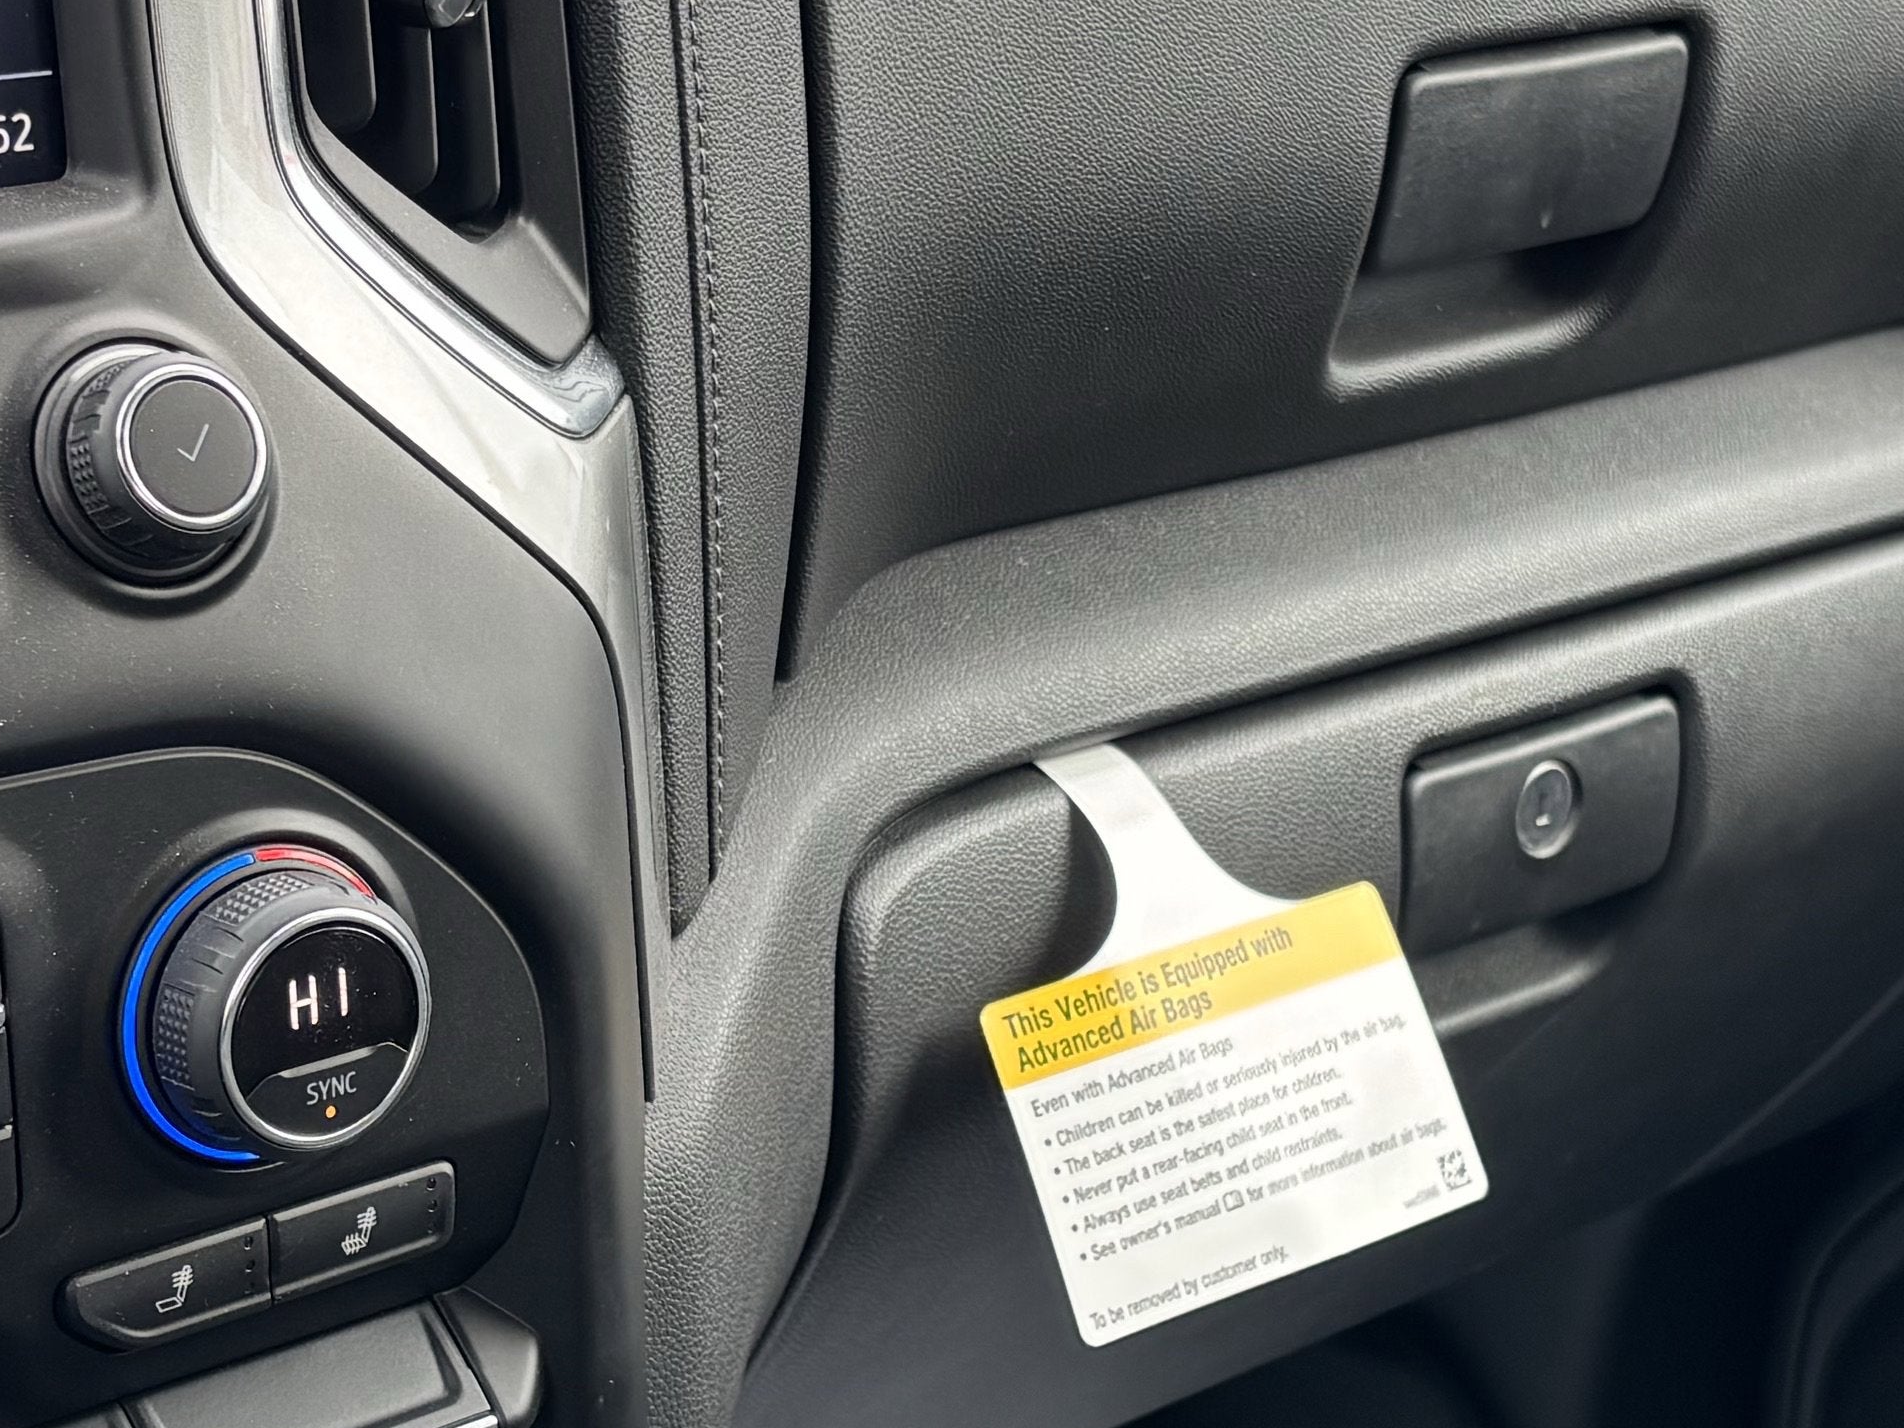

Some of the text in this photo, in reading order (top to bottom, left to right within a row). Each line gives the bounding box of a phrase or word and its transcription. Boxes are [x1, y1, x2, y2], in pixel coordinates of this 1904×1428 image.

[286, 966, 352, 1032] HI
[1001, 926, 1294, 1040] This Vehicle is Equipped with
[1017, 989, 1213, 1073] Advanced Air Bags
[304, 1073, 359, 1107] SYNC
[1030, 1037, 1234, 1118] Even with Advanced Air Bags
[1055, 1114, 1116, 1147] Children
[1118, 1105, 1144, 1123] can
[1146, 1096, 1165, 1116] be
[1165, 1082, 1204, 1108] killed
[1206, 1077, 1219, 1094] or
[1222, 1057, 1279, 1089] seriously
[1280, 1040, 1322, 1070] injured
[1323, 1036, 1339, 1053] by
[1340, 1028, 1361, 1045] the
[1363, 1020, 1379, 1038] air
[1063, 1066, 1342, 1175] The back seat is the safest place for children.
[1072, 1091, 1353, 1204] Never put a rear-facing child seat in the front.
[1082, 1126, 1344, 1233] Always use seat belts and child restraints.
[1090, 1242, 1117, 1261] See
[1120, 1220, 1173, 1250] owner's
[1174, 1199, 1221, 1230] manual
[1246, 1185, 1265, 1202] for
[1266, 1173, 1299, 1197] more
[1301, 1146, 1366, 1183] information
[1367, 1133, 1399, 1160] about
[1399, 1127, 1415, 1146] air
[1089, 1311, 1107, 1331] To
[1108, 1306, 1126, 1324] be
[1127, 1283, 1182, 1318] removed
[1183, 1278, 1200, 1297] by
[1201, 1254, 1258, 1289] customer
